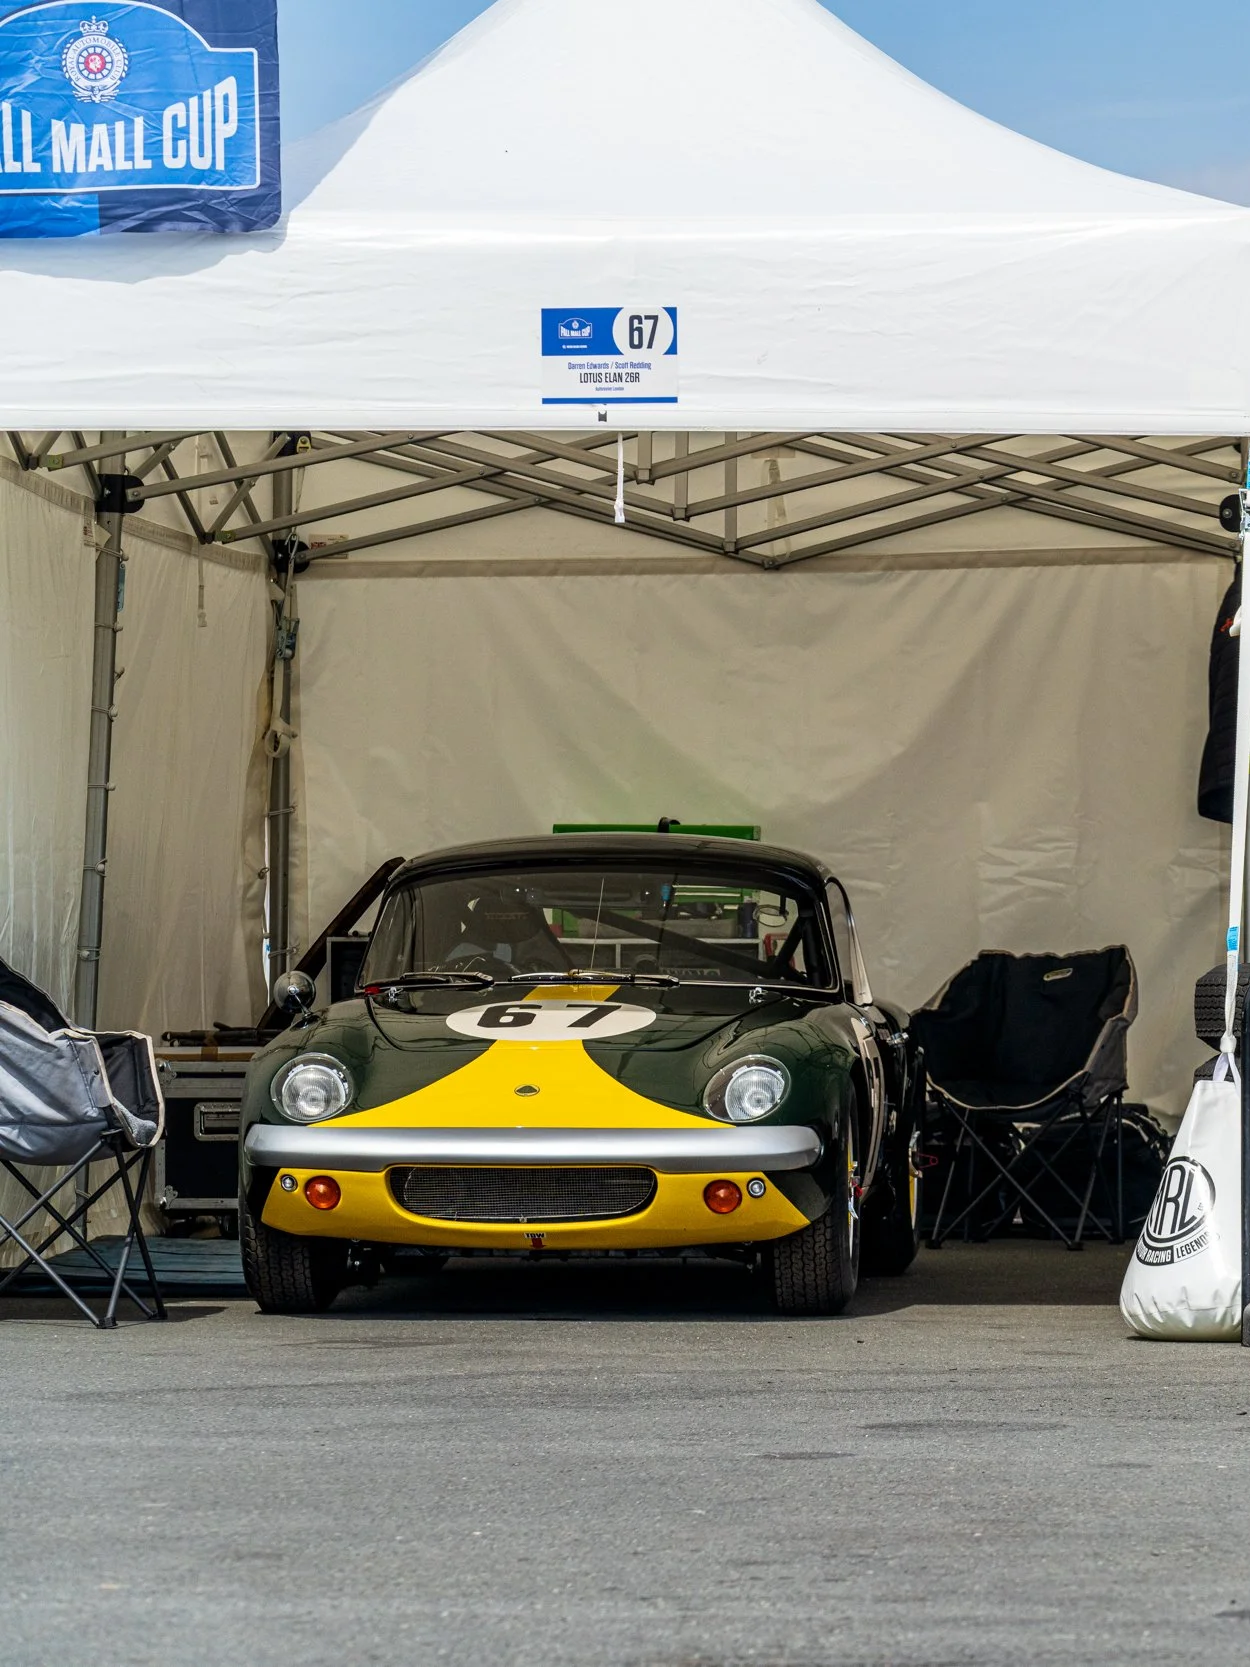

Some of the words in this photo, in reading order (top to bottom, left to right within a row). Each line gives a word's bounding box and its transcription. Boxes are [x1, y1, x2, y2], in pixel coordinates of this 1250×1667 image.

[73, 37, 120, 57] AUTOMOBILE
[0, 101, 41, 173] LL
[52, 116, 152, 173] MALL
[163, 75, 238, 171] CUP
[628, 314, 659, 350] 67
[568, 361, 586, 370] Darren
[587, 361, 609, 370] Edwards
[630, 361, 652, 371] Redding
[579, 372, 603, 384] LOTUS
[604, 372, 623, 383] ELAN
[625, 372, 640, 383] 26R
[476, 1003, 622, 1029] 67
[1145, 1248, 1172, 1264] RACING
[1176, 1230, 1210, 1259] LEGEND
